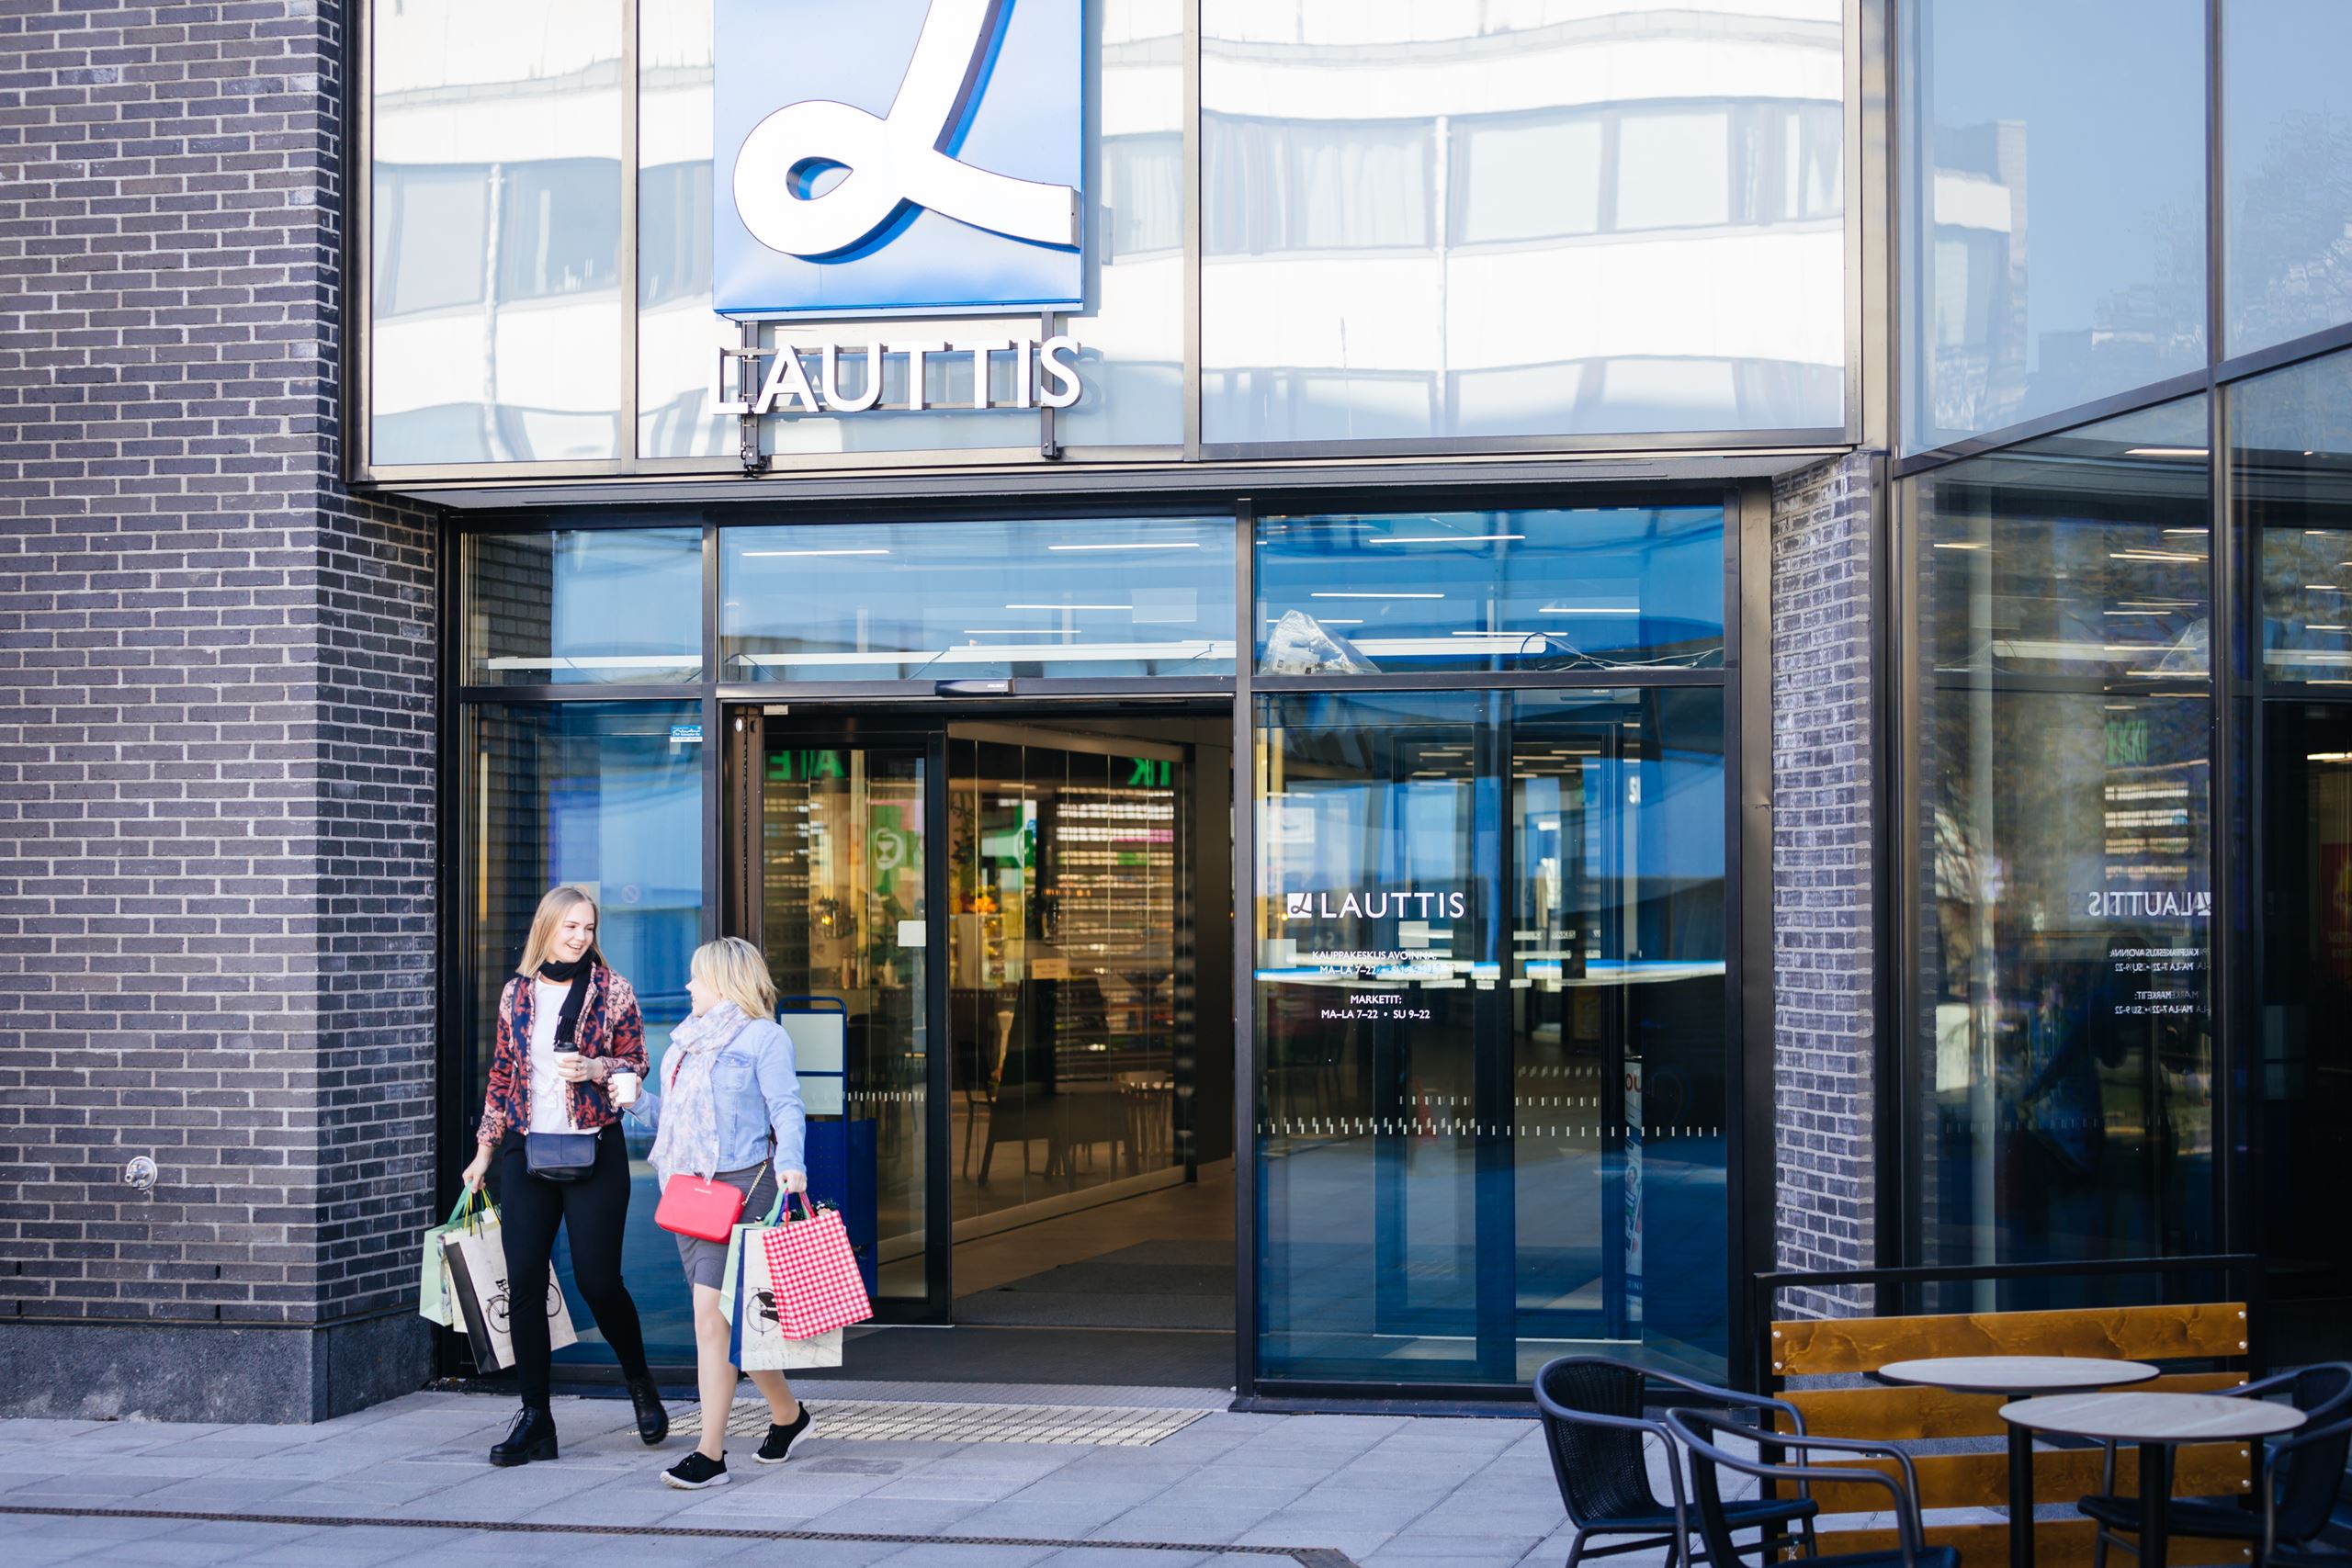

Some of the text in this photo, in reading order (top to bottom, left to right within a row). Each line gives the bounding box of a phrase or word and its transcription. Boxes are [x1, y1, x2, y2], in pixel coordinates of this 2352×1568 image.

[708, 335, 1082, 415] LAUTTIS
[1321, 892, 1465, 919] LAUTTIS
[1312, 951, 1386, 960] KAUPPAKESKUS
[1319, 965, 1353, 975] MA–LA
[1355, 965, 1376, 975] 7–22
[1350, 995, 1402, 1004] MARKETIT:
[1321, 1010, 1430, 1019] MA–LA 7–22 SU 9–22
